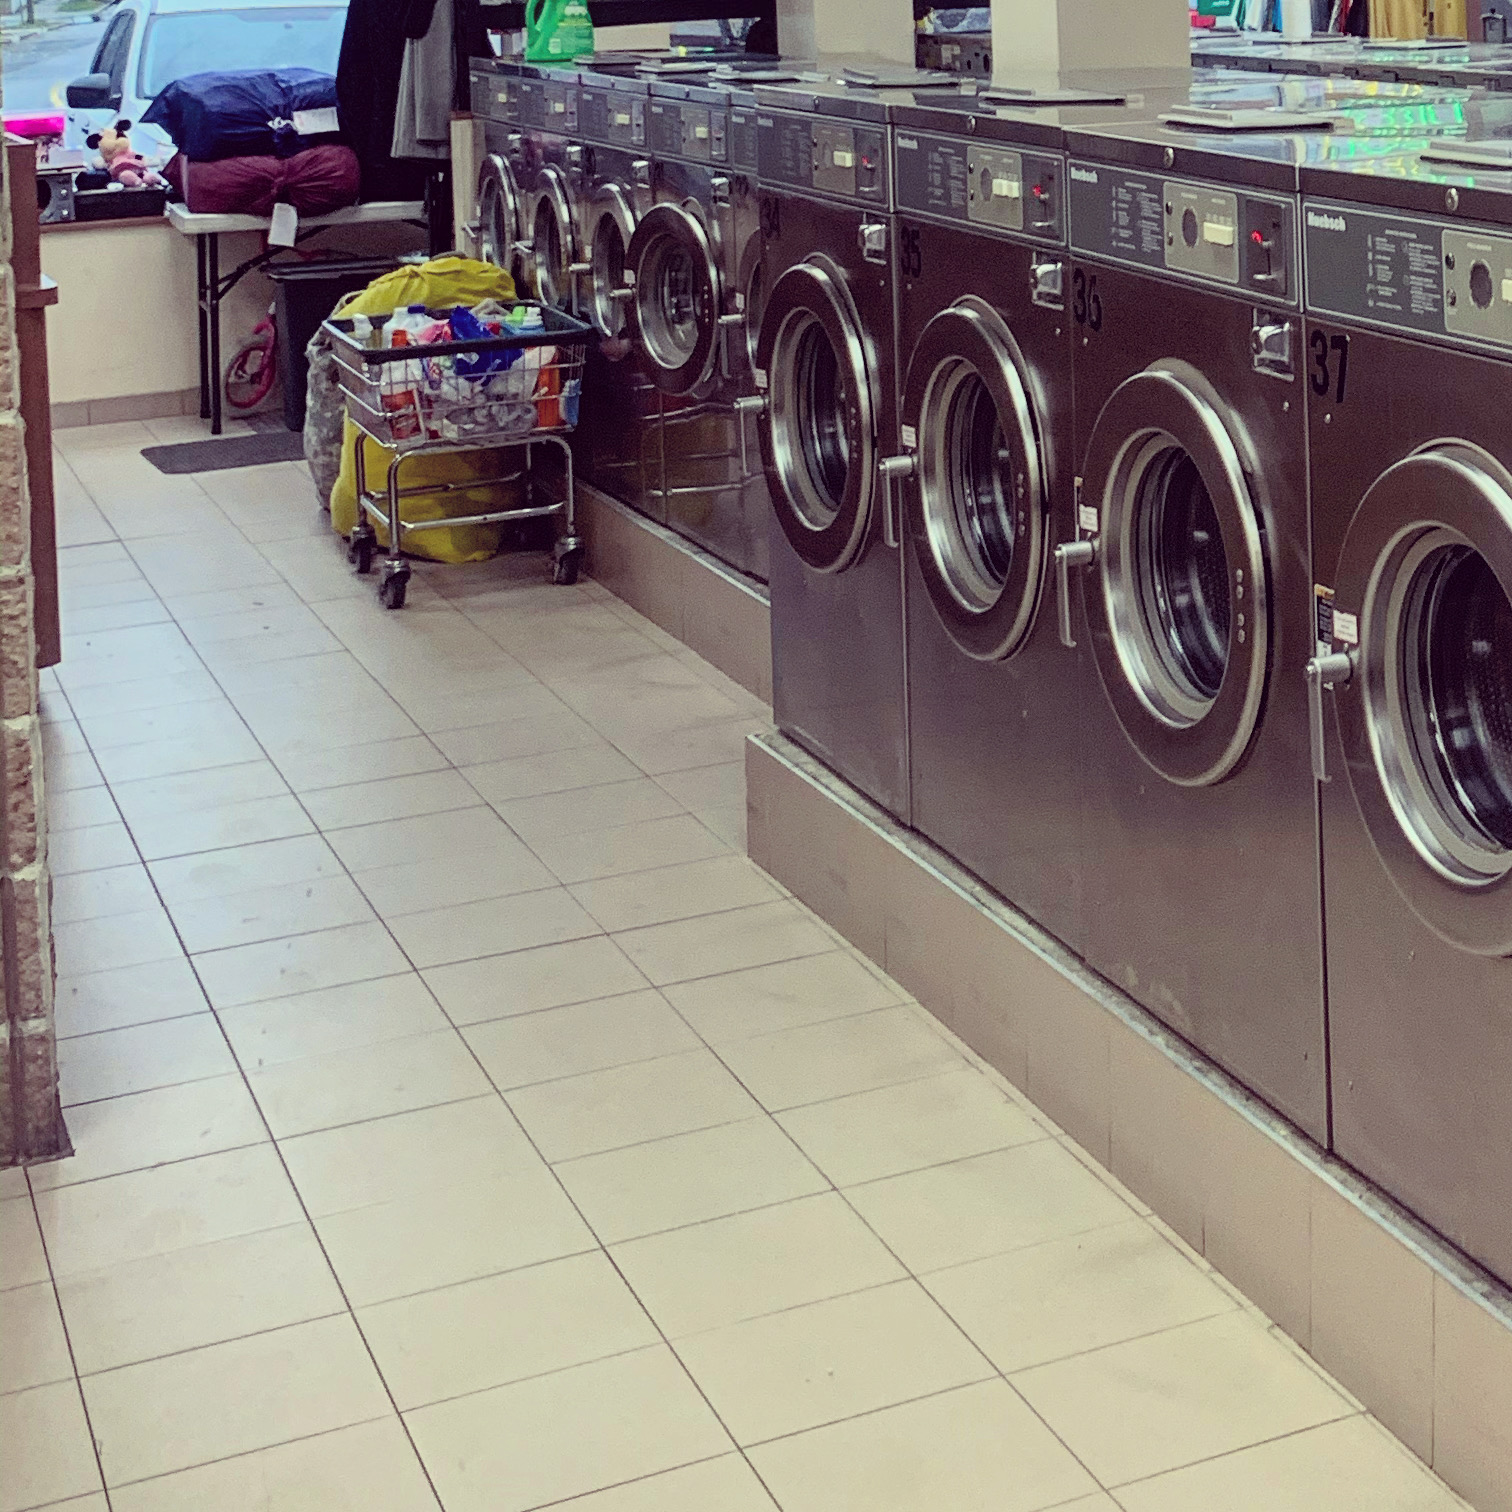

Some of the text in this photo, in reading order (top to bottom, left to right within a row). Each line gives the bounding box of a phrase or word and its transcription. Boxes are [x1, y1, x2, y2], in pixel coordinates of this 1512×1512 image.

[1307, 211, 1346, 232] Huebsch
[1072, 267, 1101, 332] 36
[1310, 329, 1350, 404] 37
